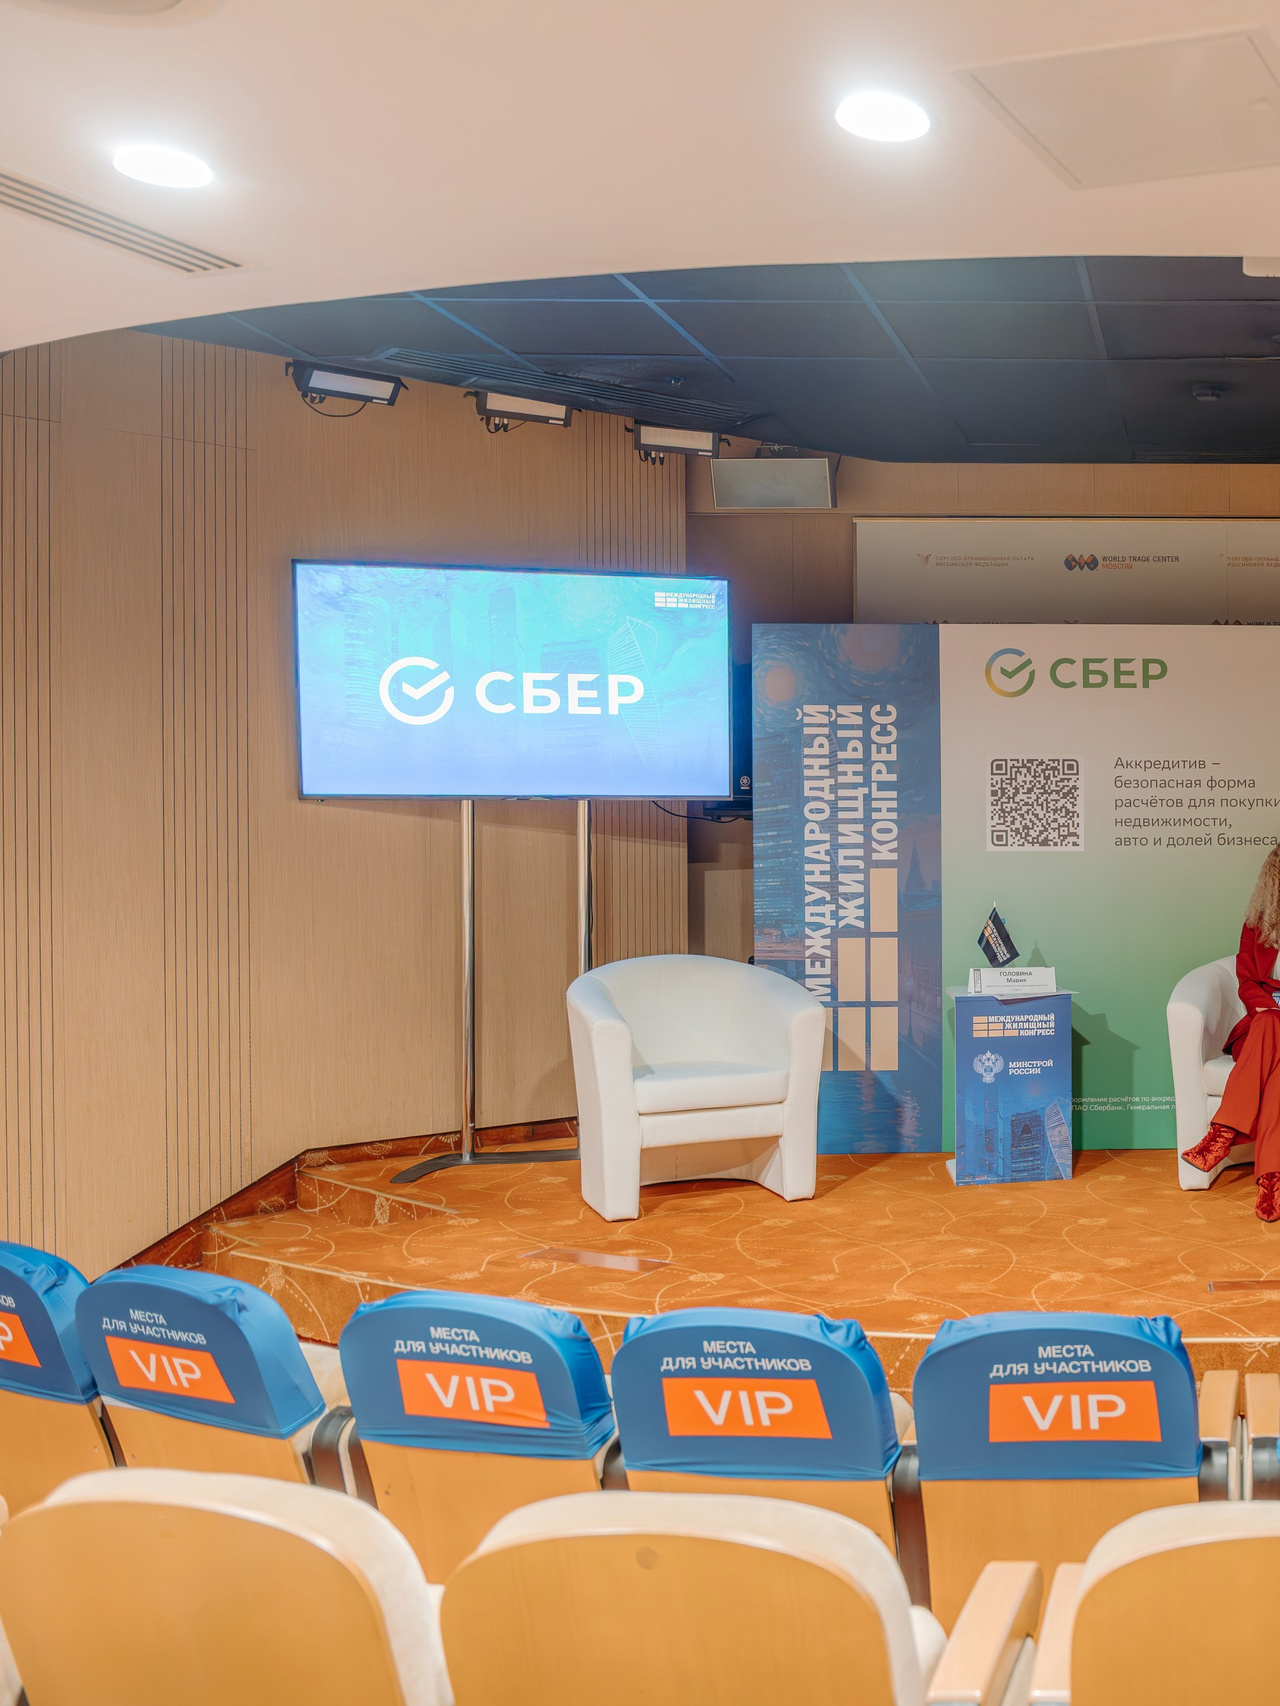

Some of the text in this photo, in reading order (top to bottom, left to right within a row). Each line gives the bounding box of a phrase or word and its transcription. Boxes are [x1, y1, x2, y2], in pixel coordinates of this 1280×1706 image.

[1050, 657, 1168, 689] СБЕР
[475, 671, 645, 715] СБЕР
[1114, 757, 1206, 771] Аккредитив
[871, 704, 898, 861] КОНГРЕСС
[1114, 776, 1256, 791] безопасная форма
[1114, 795, 1184, 810] расчётов
[1188, 796, 1216, 810] для
[829, 704, 869, 929] ЖИЛИЩНЫЙ
[1115, 815, 1233, 829] недвижимости,
[1115, 831, 1278, 848] авто и долей бизнеса
[796, 704, 836, 1002] МЕЖДУНАРОДНЫЙ
[988, 1013, 1055, 1023] МЕЖДУНАРОДНЫЙ
[1005, 1021, 1055, 1030] ЖИЛИЩНЫЙ
[1009, 1059, 1053, 1068] МИНСТРОЙ
[1009, 1067, 1041, 1075] РОССИИ
[130, 1308, 167, 1326] МЕСТА
[102, 1317, 207, 1345] ДЛЯ УЧАСТНИКОВ
[429, 1326, 480, 1343] МЕСТА
[394, 1340, 533, 1365] ДЛЯ УЧАСТНИКОВ
[702, 1340, 757, 1355] МЕСТА
[1037, 1345, 1095, 1358] МЕСТА
[130, 1350, 201, 1388] VIP
[661, 1356, 812, 1372] ДЛЯ УЧАСТНИКОВ
[989, 1359, 1152, 1378] ДЛЯ УЧАСТНИКОВ
[425, 1373, 515, 1413] VIP
[693, 1390, 794, 1426] VIP
[1022, 1394, 1127, 1430] VIP
